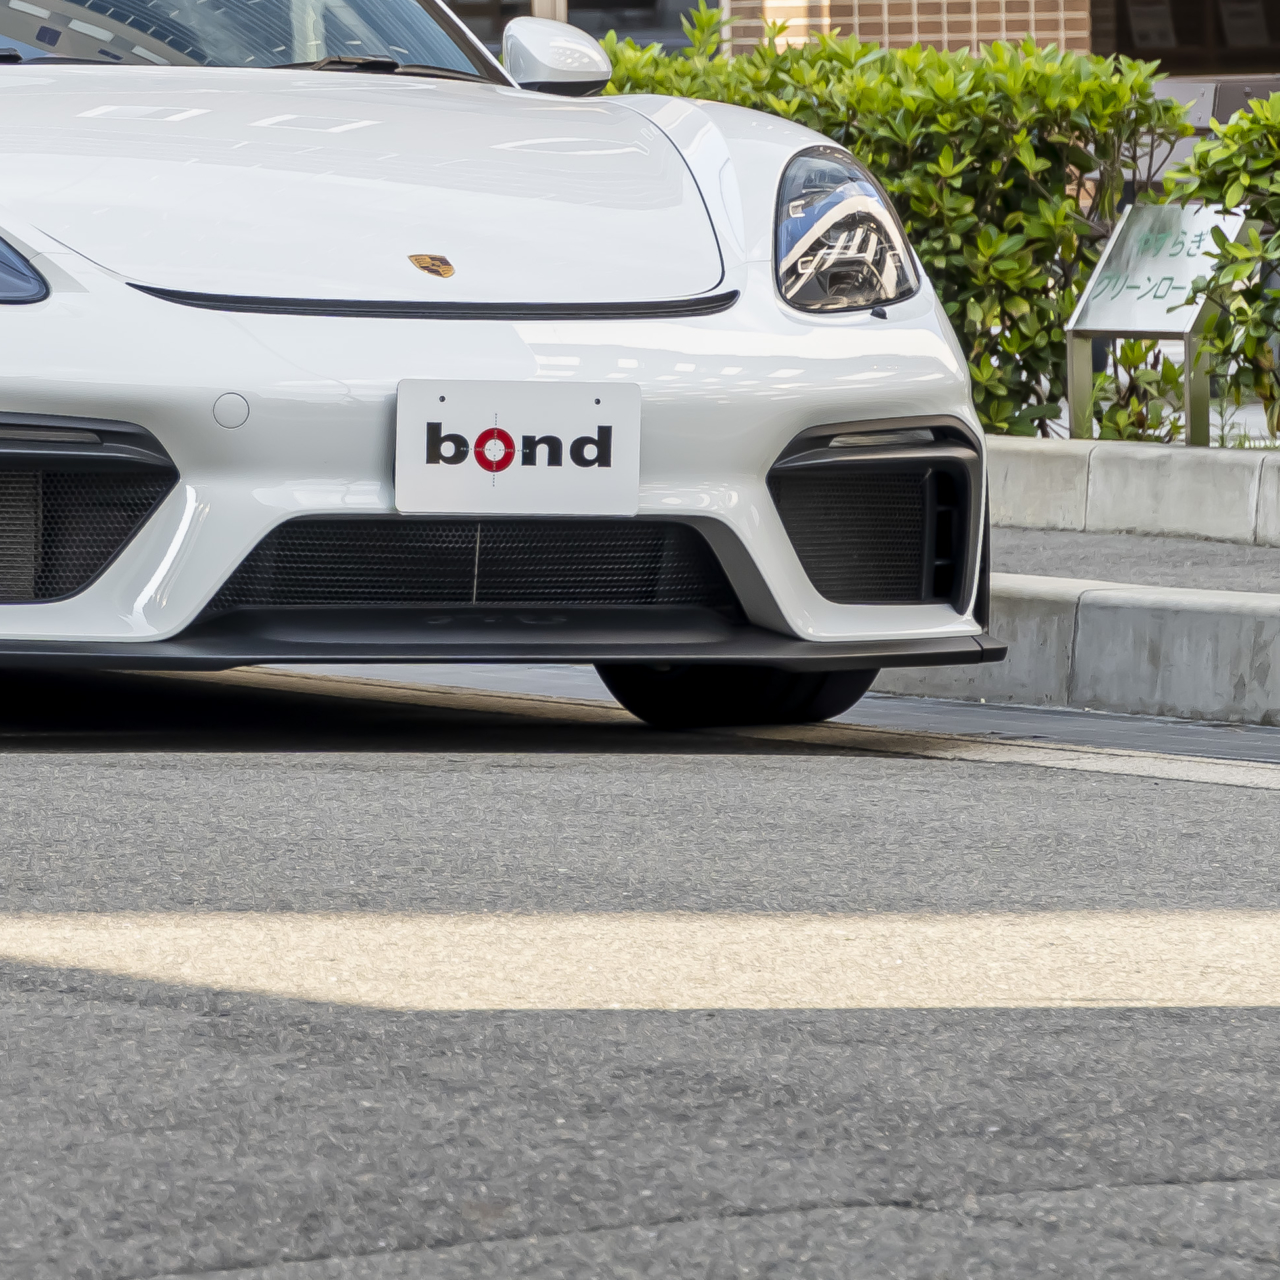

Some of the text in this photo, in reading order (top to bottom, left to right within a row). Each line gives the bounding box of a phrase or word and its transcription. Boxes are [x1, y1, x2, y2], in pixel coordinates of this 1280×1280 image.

[1091, 271, 1196, 301] グリーンロー
[426, 422, 613, 473] bond
